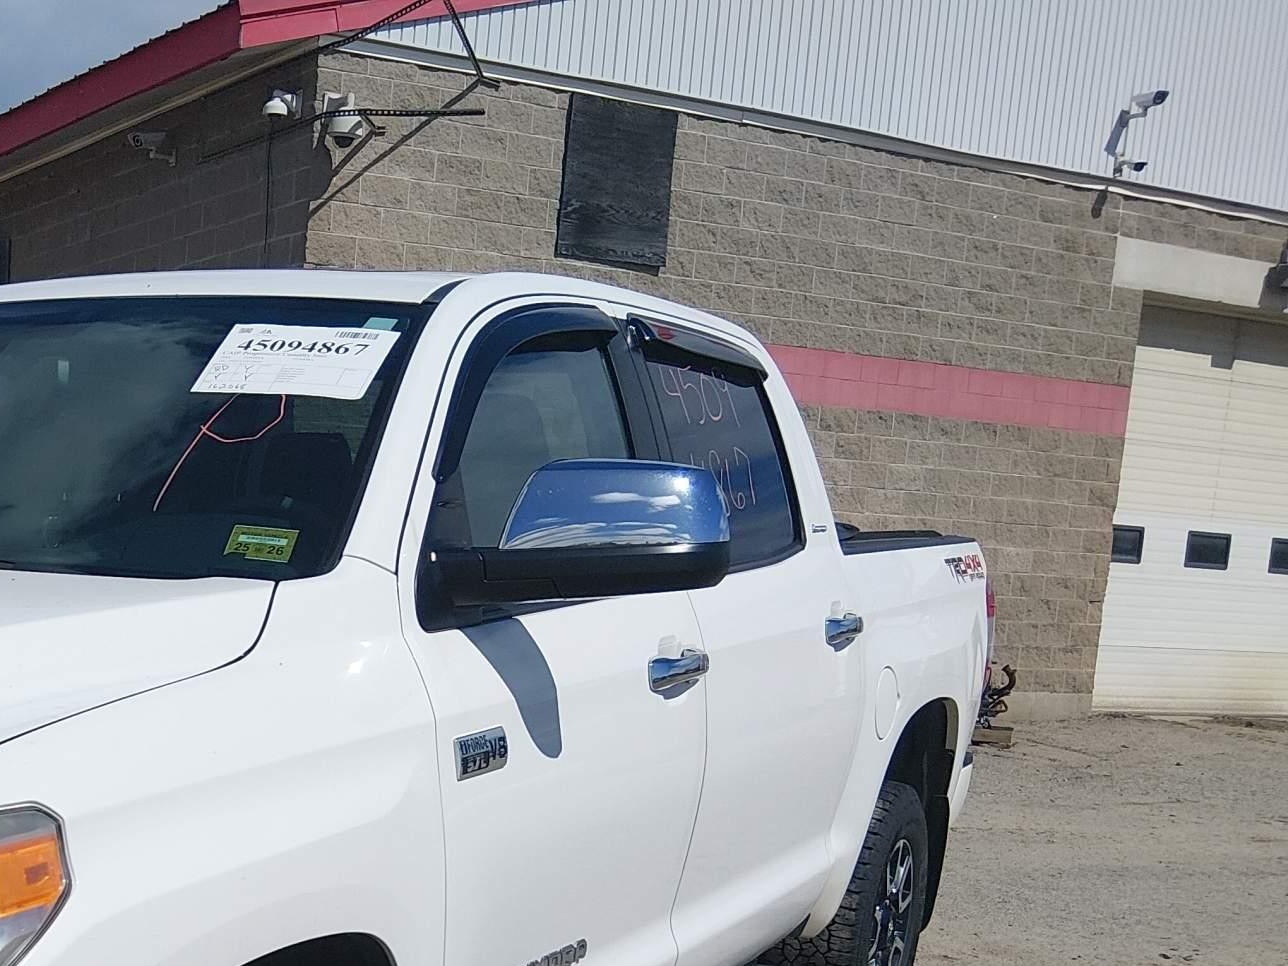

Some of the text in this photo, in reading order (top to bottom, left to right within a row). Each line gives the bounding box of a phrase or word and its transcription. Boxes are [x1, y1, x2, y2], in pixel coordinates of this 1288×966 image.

[238, 339, 370, 356] 45094867
[233, 542, 250, 551] 25
[266, 545, 285, 555] 26
